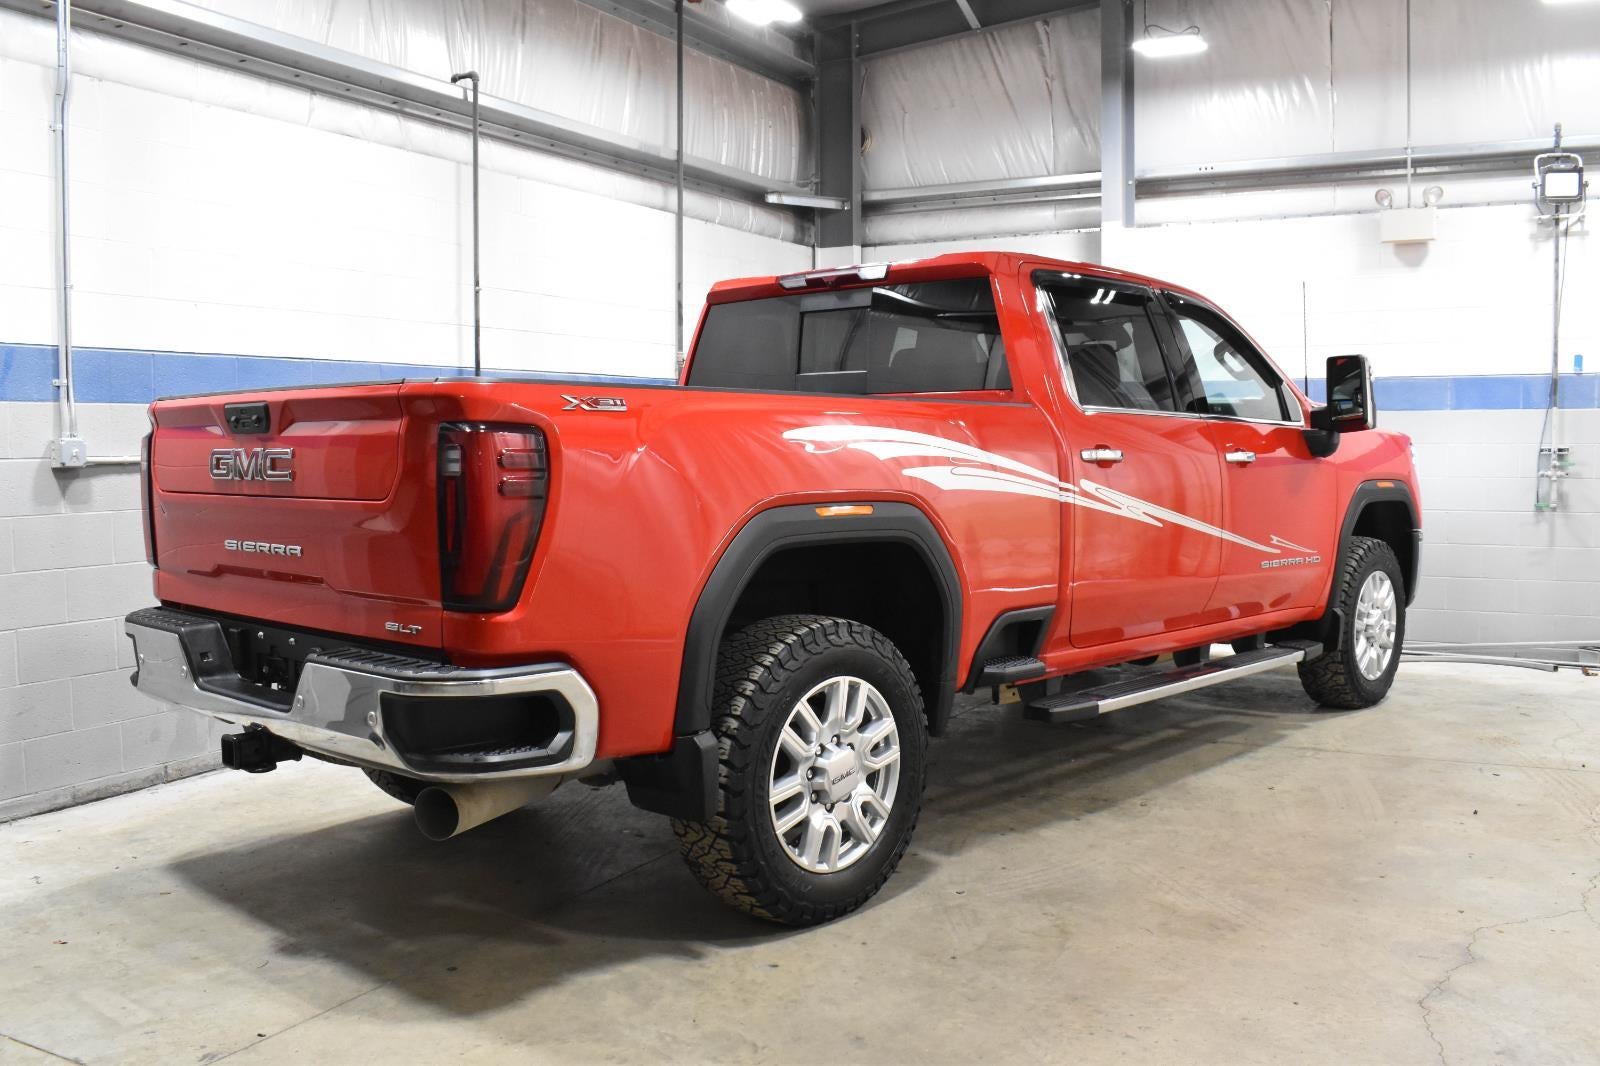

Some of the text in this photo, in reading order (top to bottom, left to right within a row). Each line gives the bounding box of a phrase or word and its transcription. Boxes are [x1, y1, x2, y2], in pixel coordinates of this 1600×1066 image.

[209, 447, 294, 481] GMC
[224, 539, 302, 557] SIERRA
[1261, 555, 1321, 569] SIERRA HD
[385, 621, 422, 635] SLT
[832, 768, 855, 785] GMC
